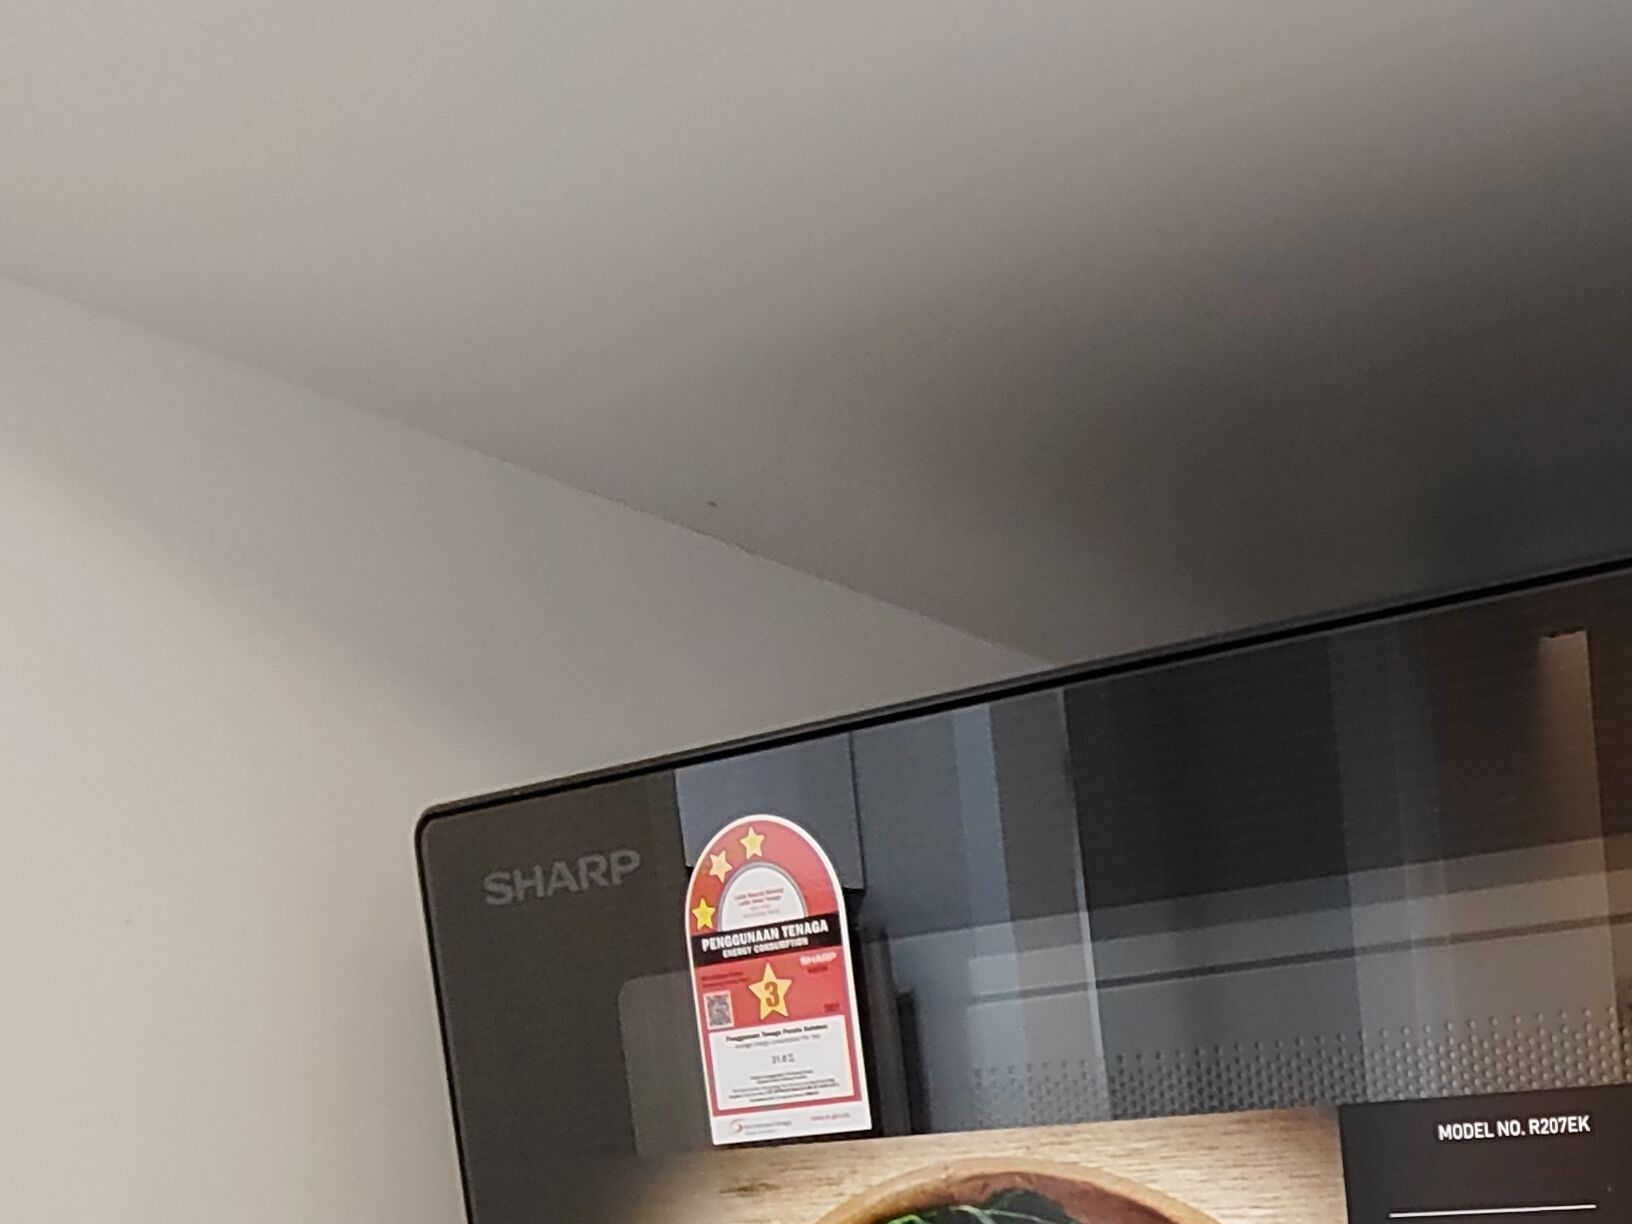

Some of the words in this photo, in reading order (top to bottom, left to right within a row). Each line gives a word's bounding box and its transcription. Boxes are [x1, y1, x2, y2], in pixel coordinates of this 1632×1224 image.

[483, 849, 641, 906] SHARP
[700, 926, 780, 953] PENGGUNAAN
[780, 918, 830, 940] TENAGA
[764, 980, 781, 1008] 3
[1437, 1121, 1495, 1142] MODEL
[1497, 1119, 1527, 1137] NO.
[1528, 1114, 1592, 1135] R207EK
